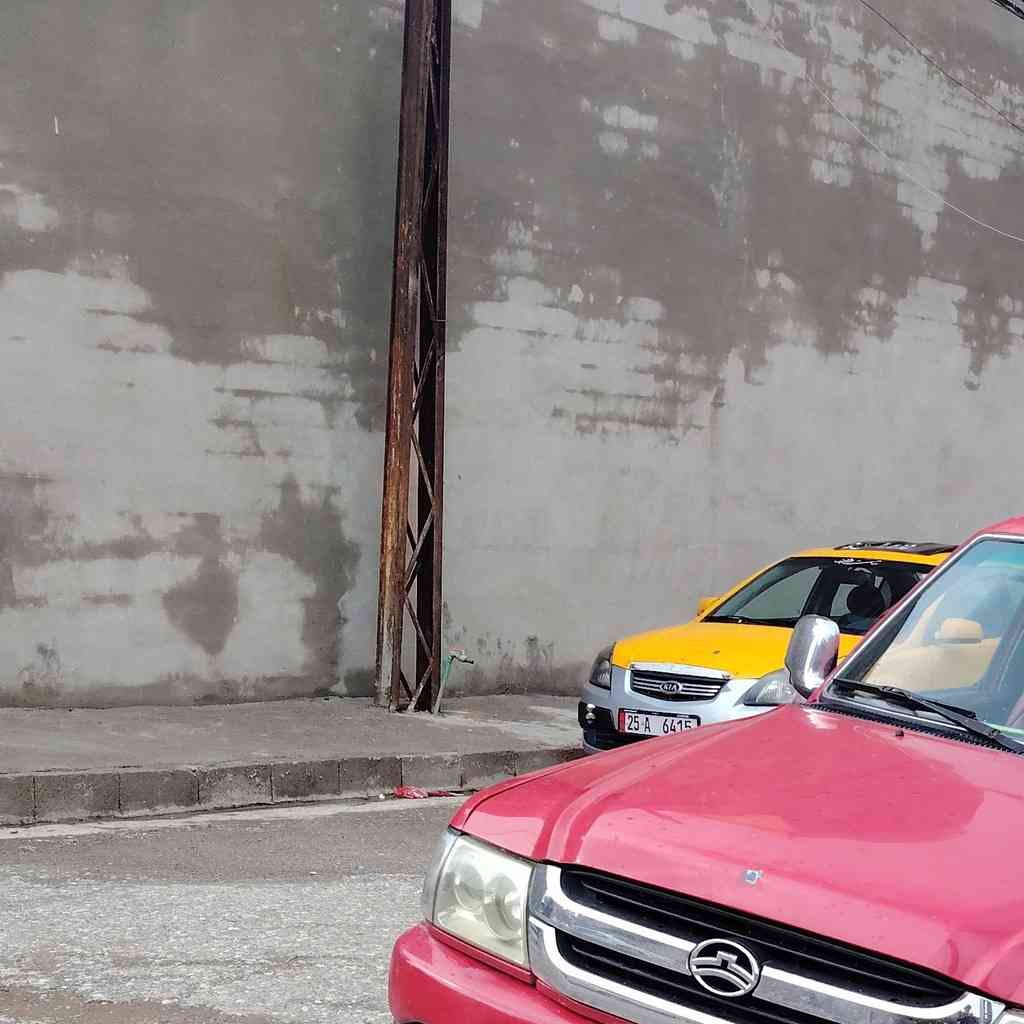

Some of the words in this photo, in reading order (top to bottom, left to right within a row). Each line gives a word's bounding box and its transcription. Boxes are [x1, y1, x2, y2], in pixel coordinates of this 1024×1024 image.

[663, 683, 677, 692] KIA
[627, 715, 640, 731] 25
[644, 717, 651, 732] A
[663, 719, 692, 734] 6415
